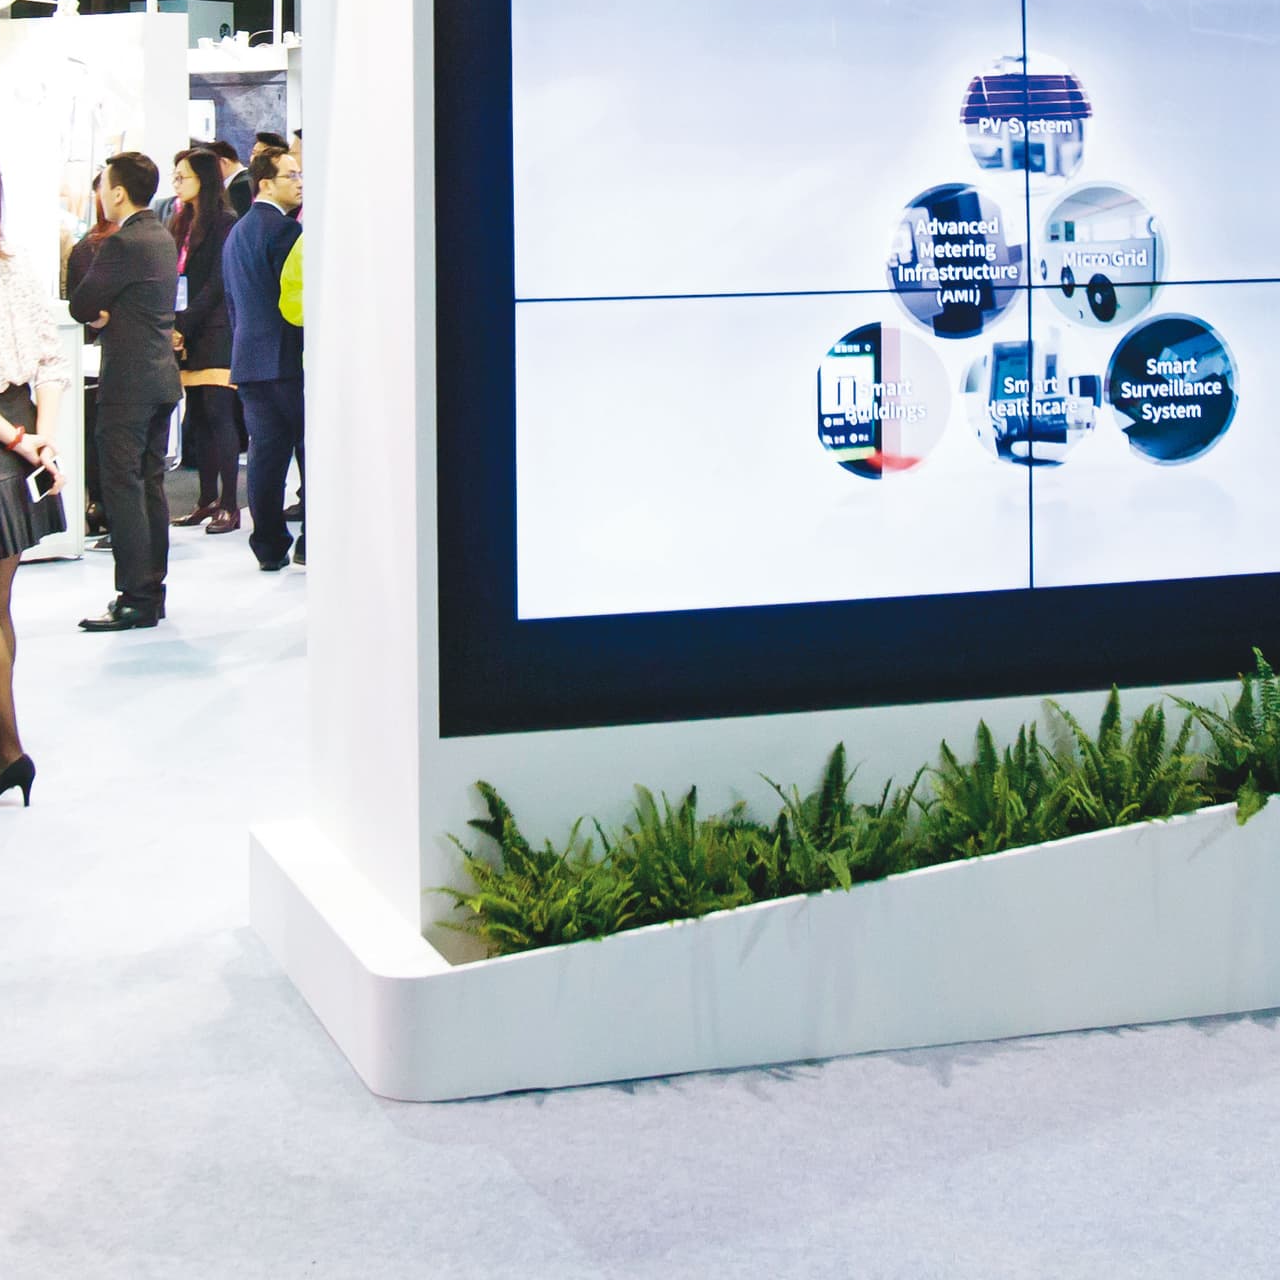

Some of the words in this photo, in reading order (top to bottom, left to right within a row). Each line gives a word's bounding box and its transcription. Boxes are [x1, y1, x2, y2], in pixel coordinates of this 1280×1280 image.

[979, 117, 1002, 134] PV
[1008, 117, 1073, 138] System
[915, 218, 999, 236] Advanced
[920, 240, 997, 261] Metering
[1063, 251, 1109, 268] Micro
[1111, 249, 1148, 267] Grid
[898, 263, 1019, 283] Infrastructure
[936, 285, 982, 307] (AMI)
[1147, 357, 1198, 376] Smart
[859, 380, 912, 397] Smart
[1003, 375, 1059, 395] Smart
[1121, 380, 1223, 400] Surveillance
[845, 401, 927, 423] Buildings
[987, 399, 1078, 418] Healthcare
[1142, 403, 1202, 424] System
